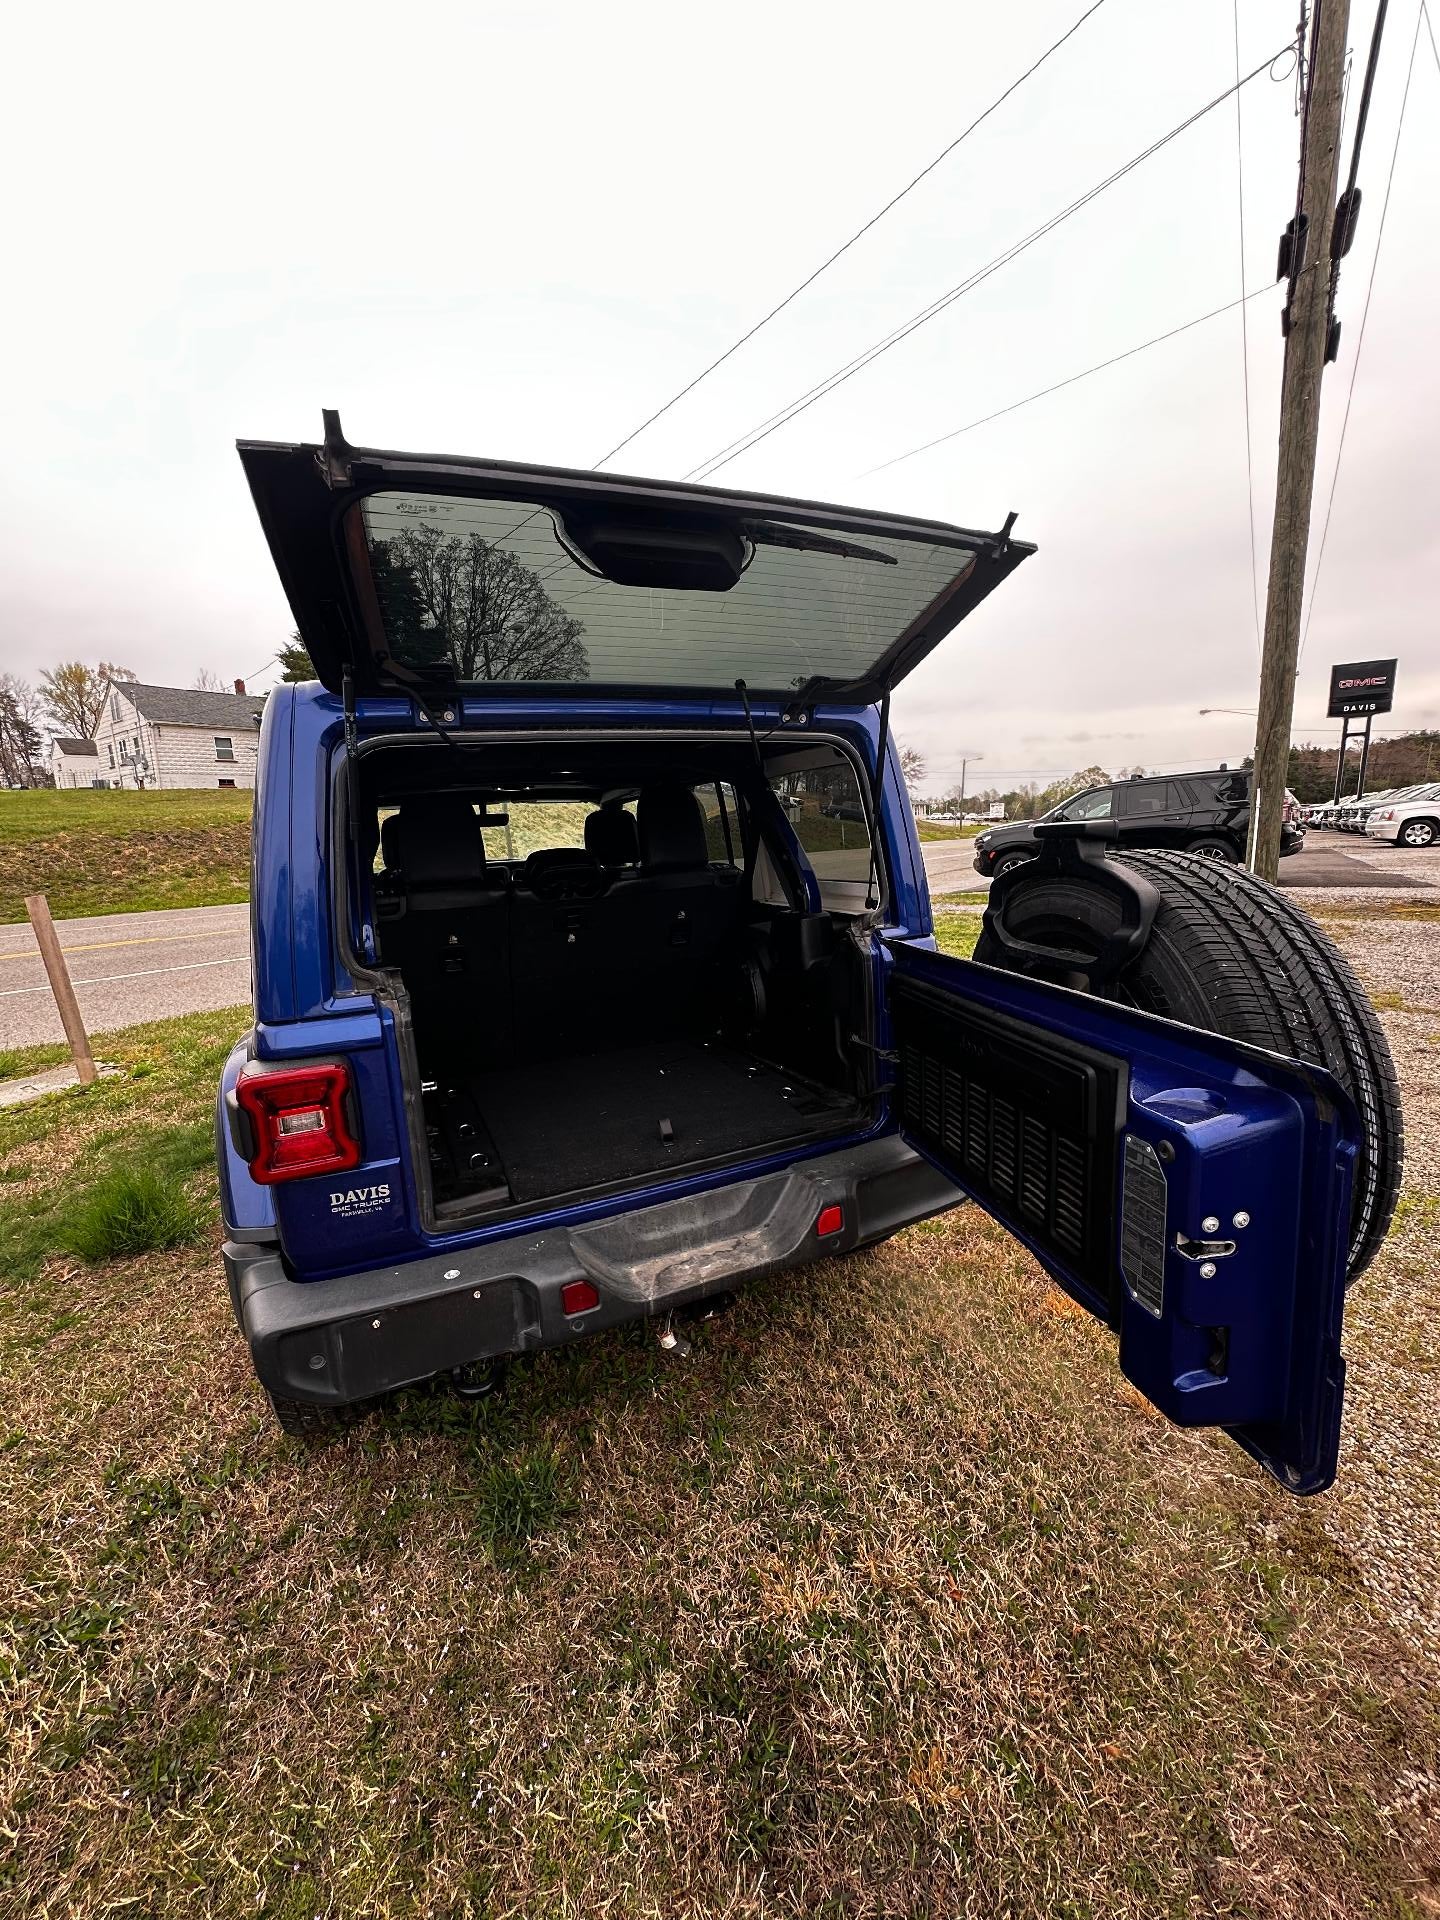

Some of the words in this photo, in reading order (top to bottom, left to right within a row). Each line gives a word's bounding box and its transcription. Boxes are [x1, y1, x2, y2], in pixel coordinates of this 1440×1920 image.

[1339, 676, 1387, 688] GMC
[1343, 703, 1376, 711] DAVIS
[330, 1184, 390, 1205] DAVIS
[331, 1205, 350, 1213] GMC
[353, 1198, 390, 1208] TRUCKS
